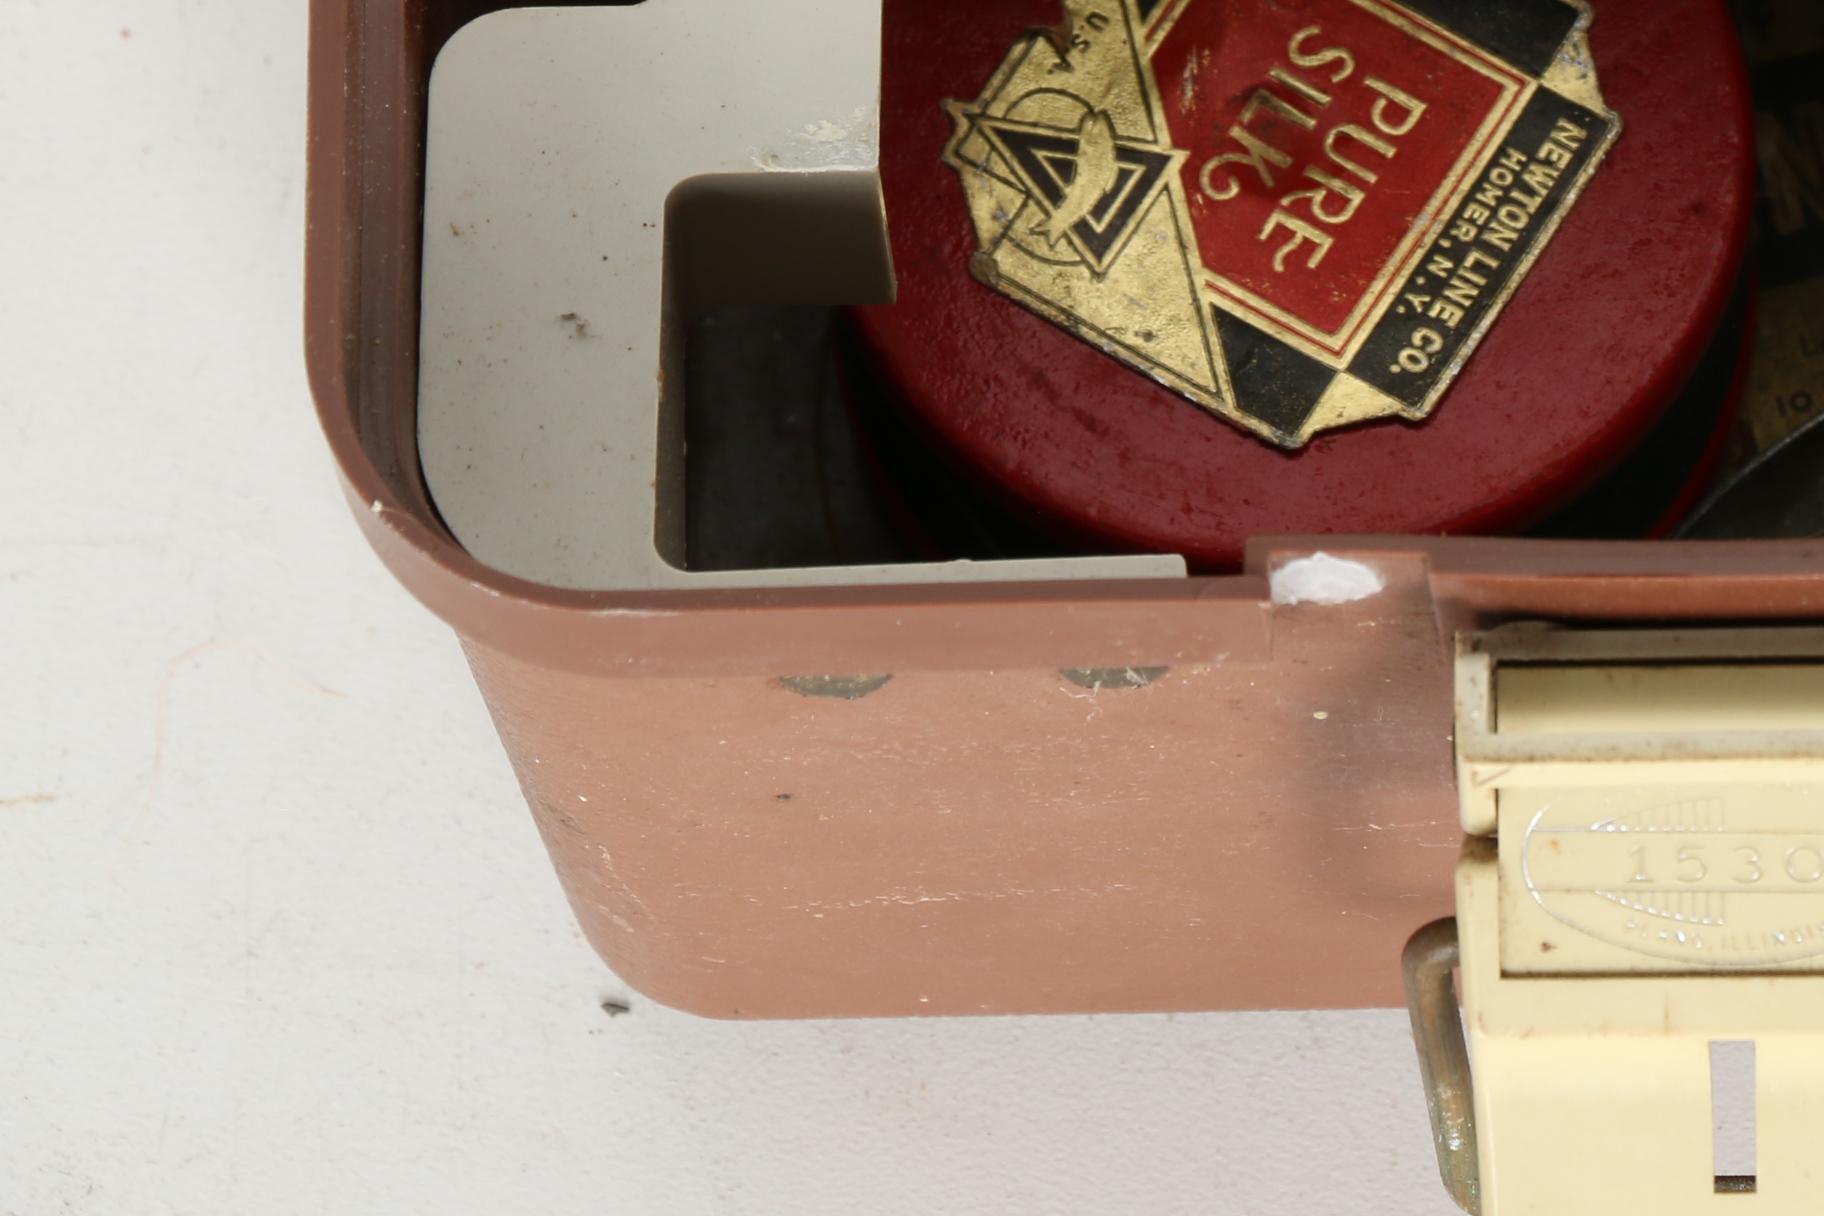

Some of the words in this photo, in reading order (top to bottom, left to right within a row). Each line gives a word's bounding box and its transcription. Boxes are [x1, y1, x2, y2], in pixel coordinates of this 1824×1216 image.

[1198, 24, 1357, 202] SILK
[1257, 75, 1428, 273] PURE
[1478, 116, 1589, 253] NEWTON
[1388, 326, 1445, 374] CO.
[1427, 246, 1502, 329] LINE
